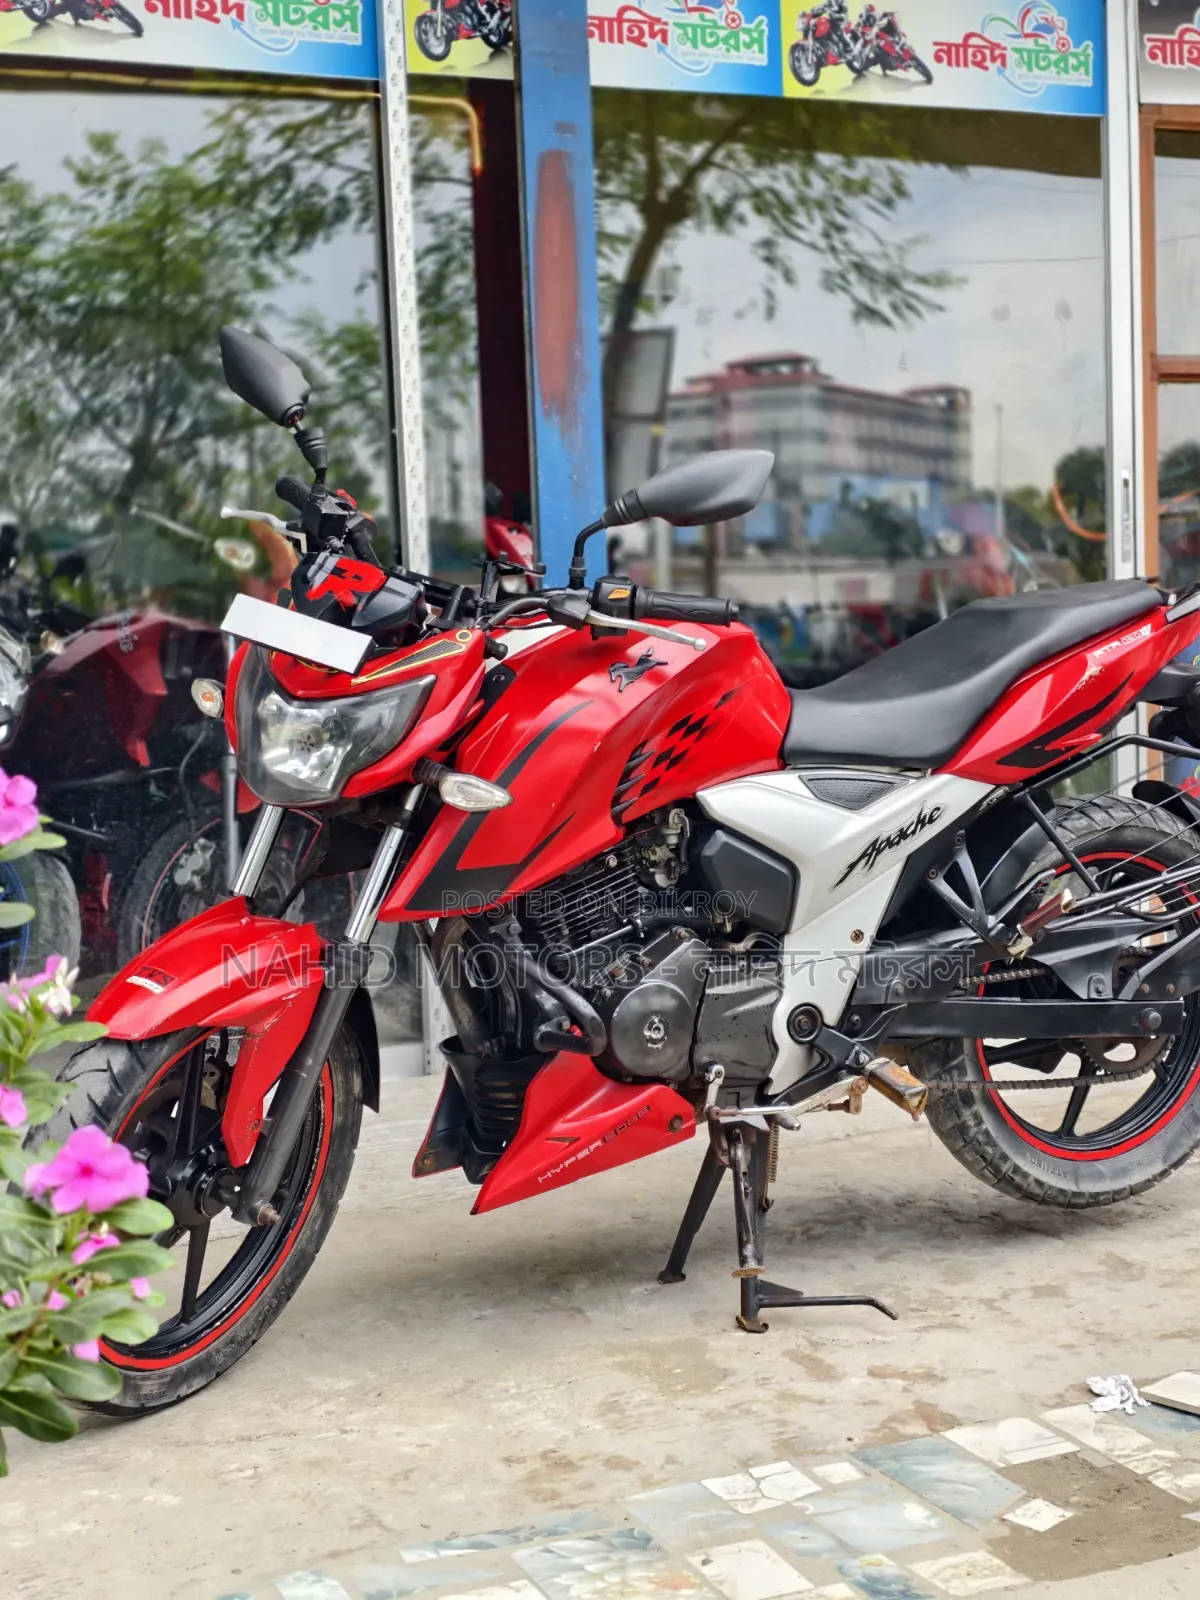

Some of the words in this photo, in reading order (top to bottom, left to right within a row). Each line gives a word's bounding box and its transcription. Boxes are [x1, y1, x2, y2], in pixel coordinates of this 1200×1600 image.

[586, 5, 669, 48] নাহিদ
[932, 31, 1007, 71] নাহিদ
[830, 803, 944, 890] Apache
[537, 1139, 603, 1183] HYPER
